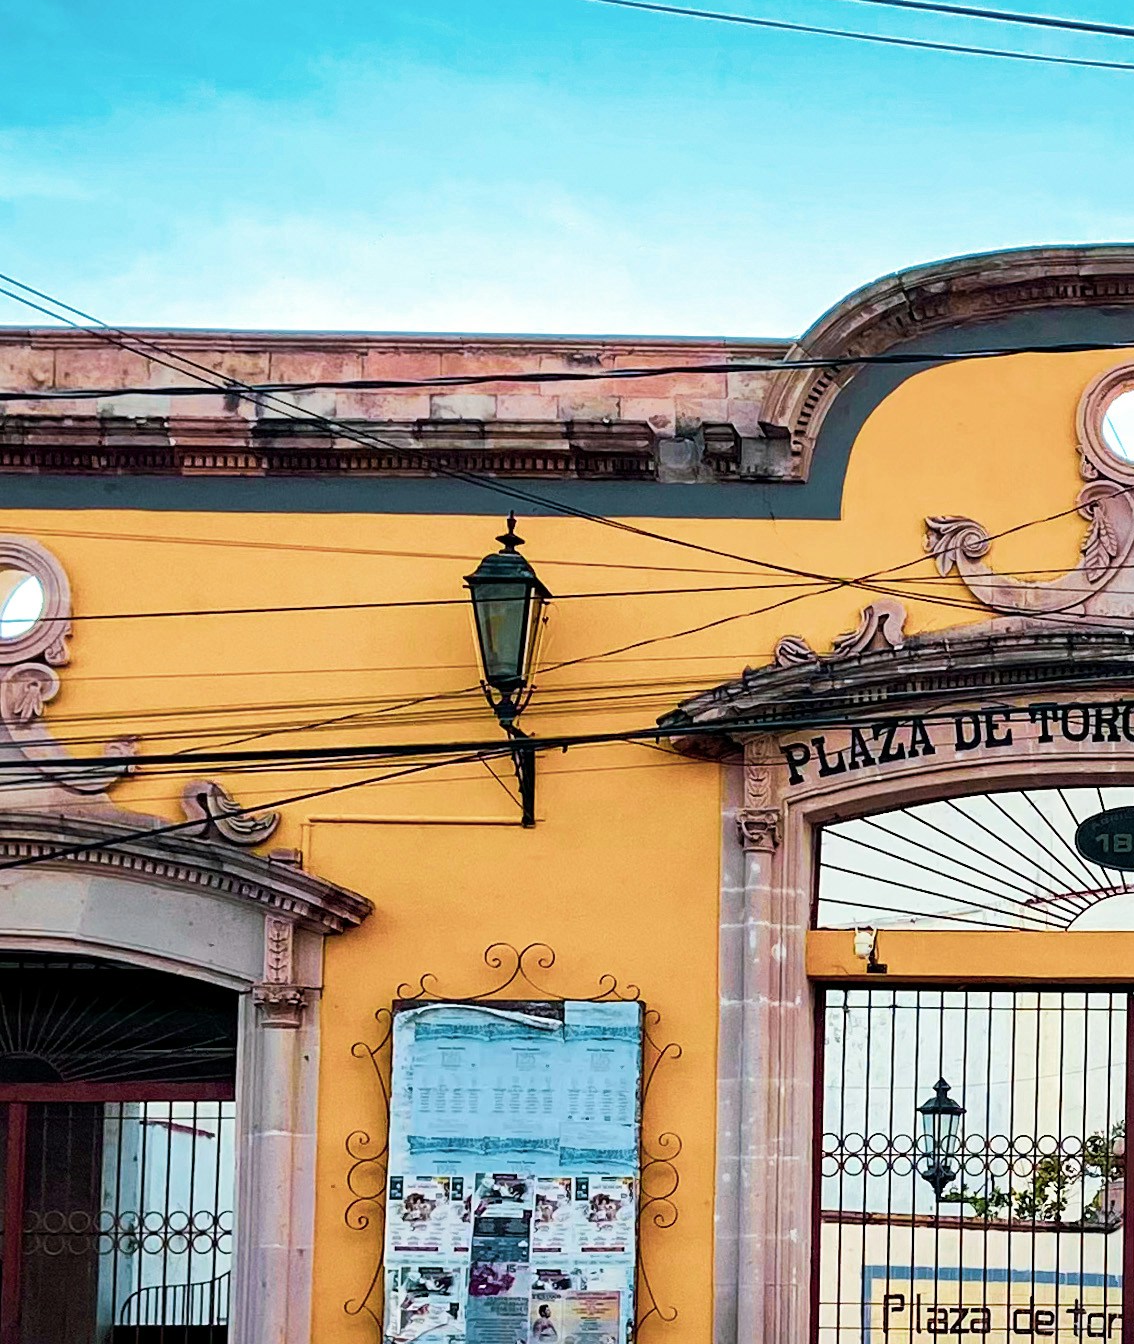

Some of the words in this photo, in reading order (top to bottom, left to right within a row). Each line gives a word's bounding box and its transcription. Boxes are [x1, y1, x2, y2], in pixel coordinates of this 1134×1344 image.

[780, 719, 936, 785] PLAZA
[954, 707, 1013, 752] DE
[883, 1293, 991, 1335] Plaza
[1013, 1296, 1056, 1336] de
